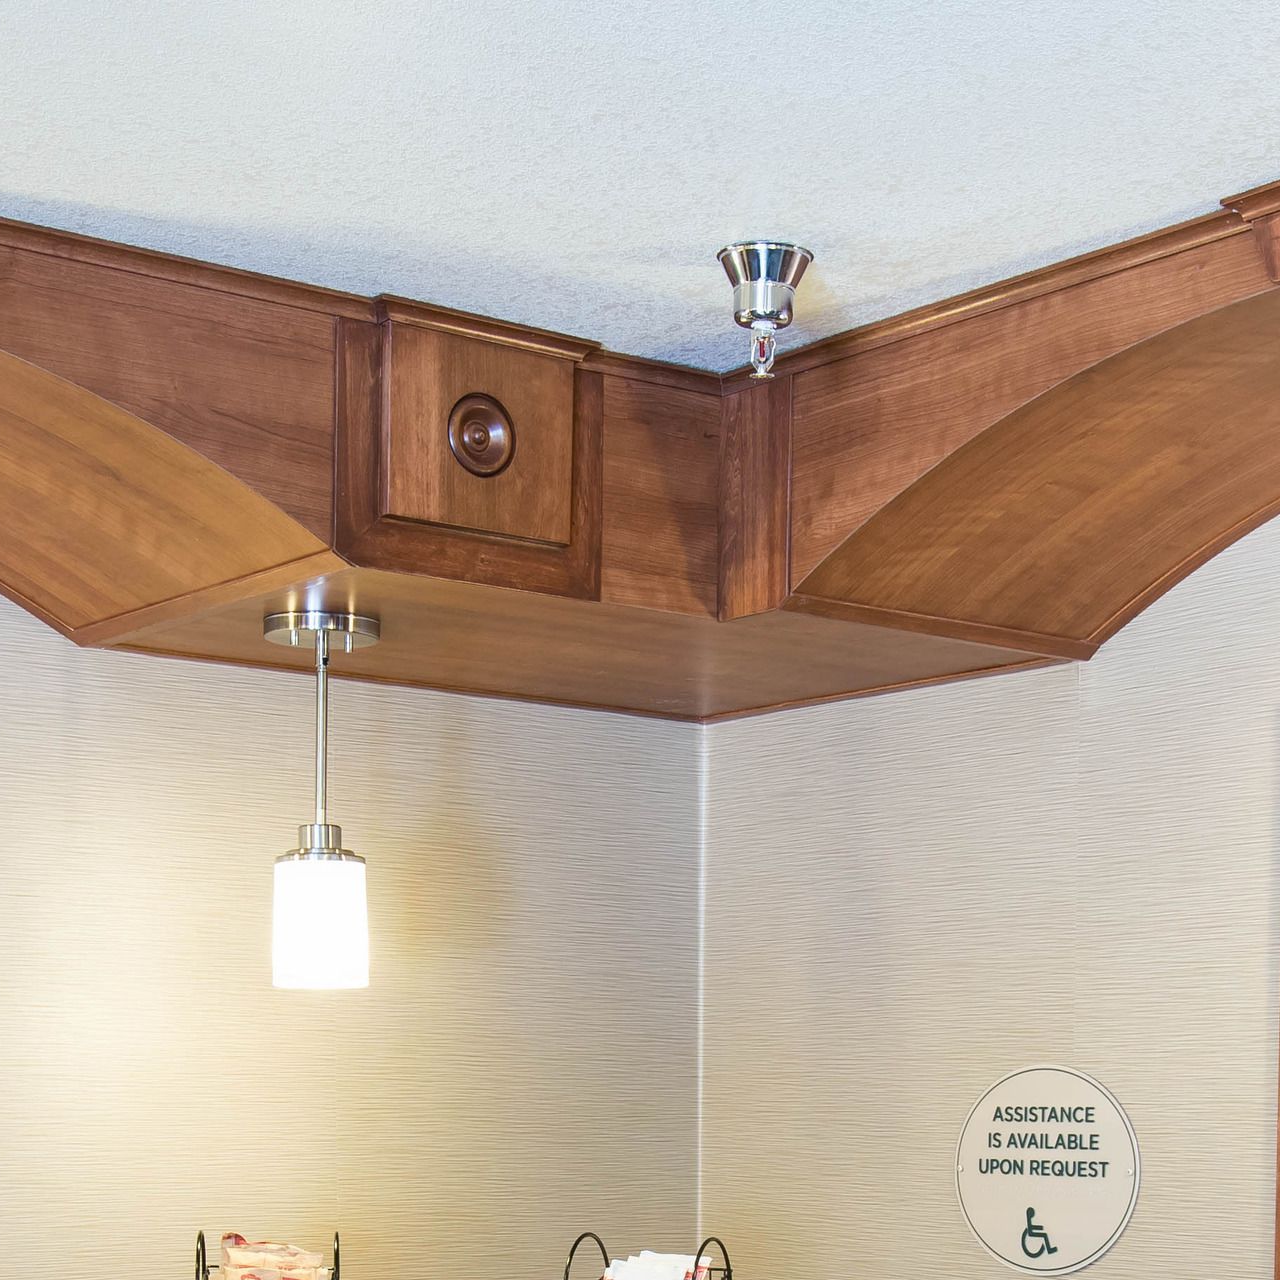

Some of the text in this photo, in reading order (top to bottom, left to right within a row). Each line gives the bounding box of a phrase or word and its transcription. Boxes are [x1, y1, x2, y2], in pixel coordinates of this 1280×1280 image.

[992, 1106, 1096, 1123] ASSISTANCE
[987, 1132, 1100, 1150] IS AVAILABLE
[978, 1158, 1109, 1178] UPON REQUEST
